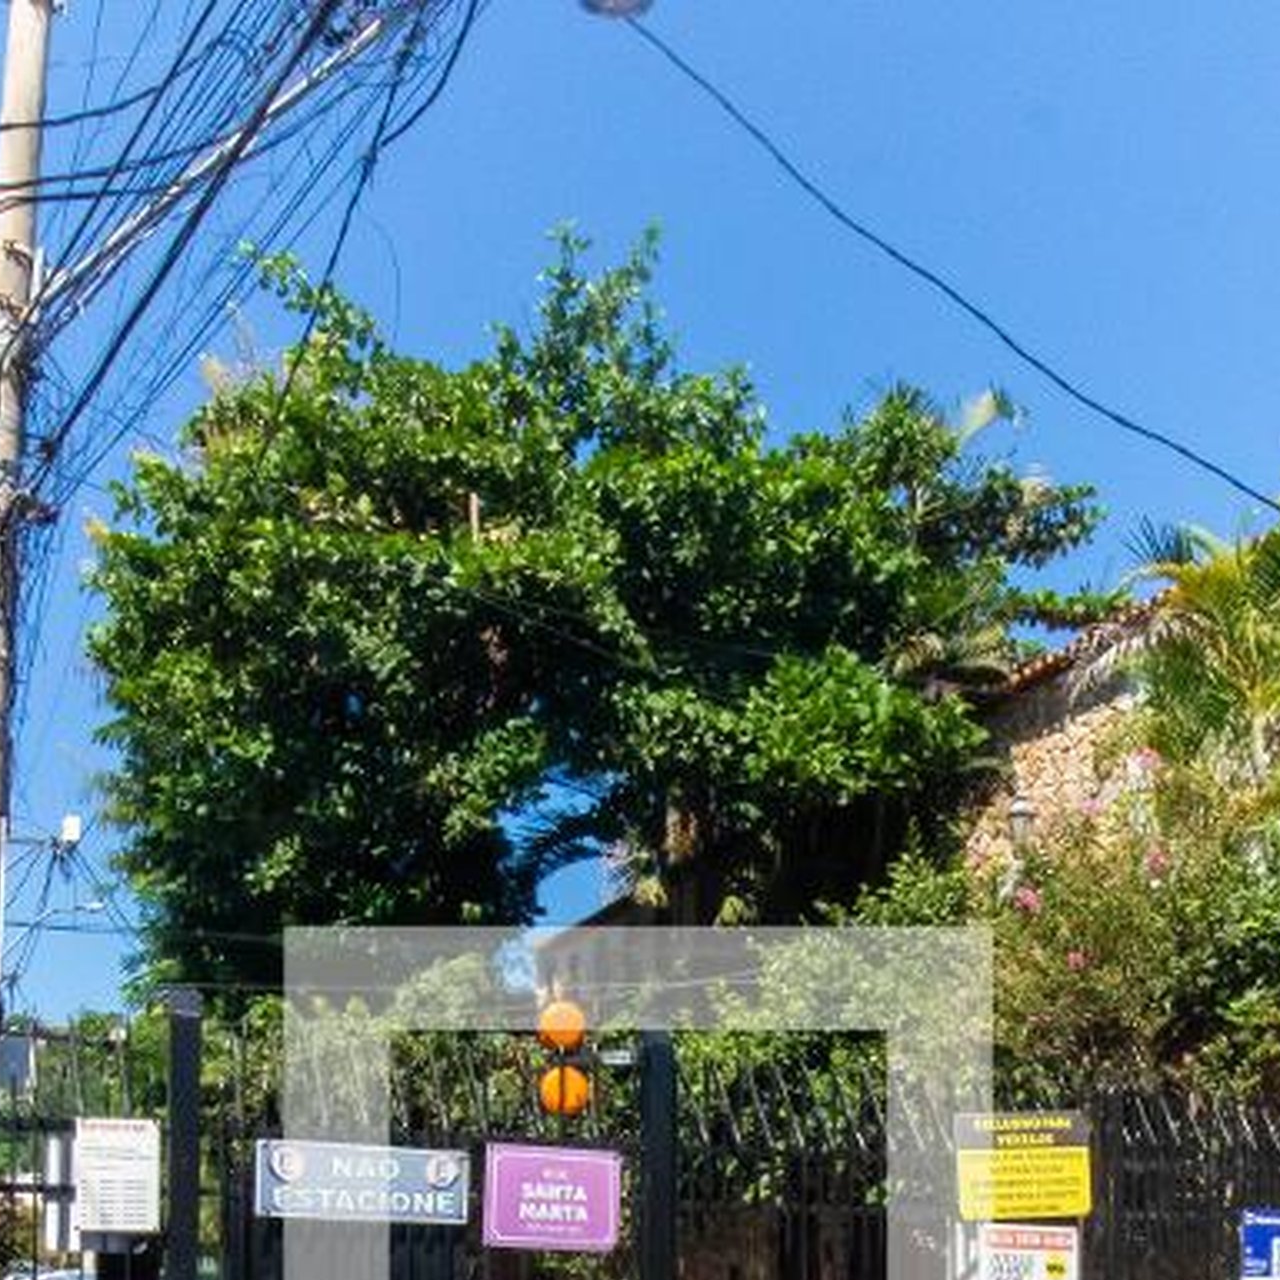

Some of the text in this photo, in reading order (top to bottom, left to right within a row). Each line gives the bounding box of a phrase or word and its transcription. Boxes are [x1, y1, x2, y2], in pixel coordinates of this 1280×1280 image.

[273, 1188, 456, 1215] ESTACIONE
[521, 1182, 588, 1202] SANTA
[519, 1202, 588, 1221] MARTA
